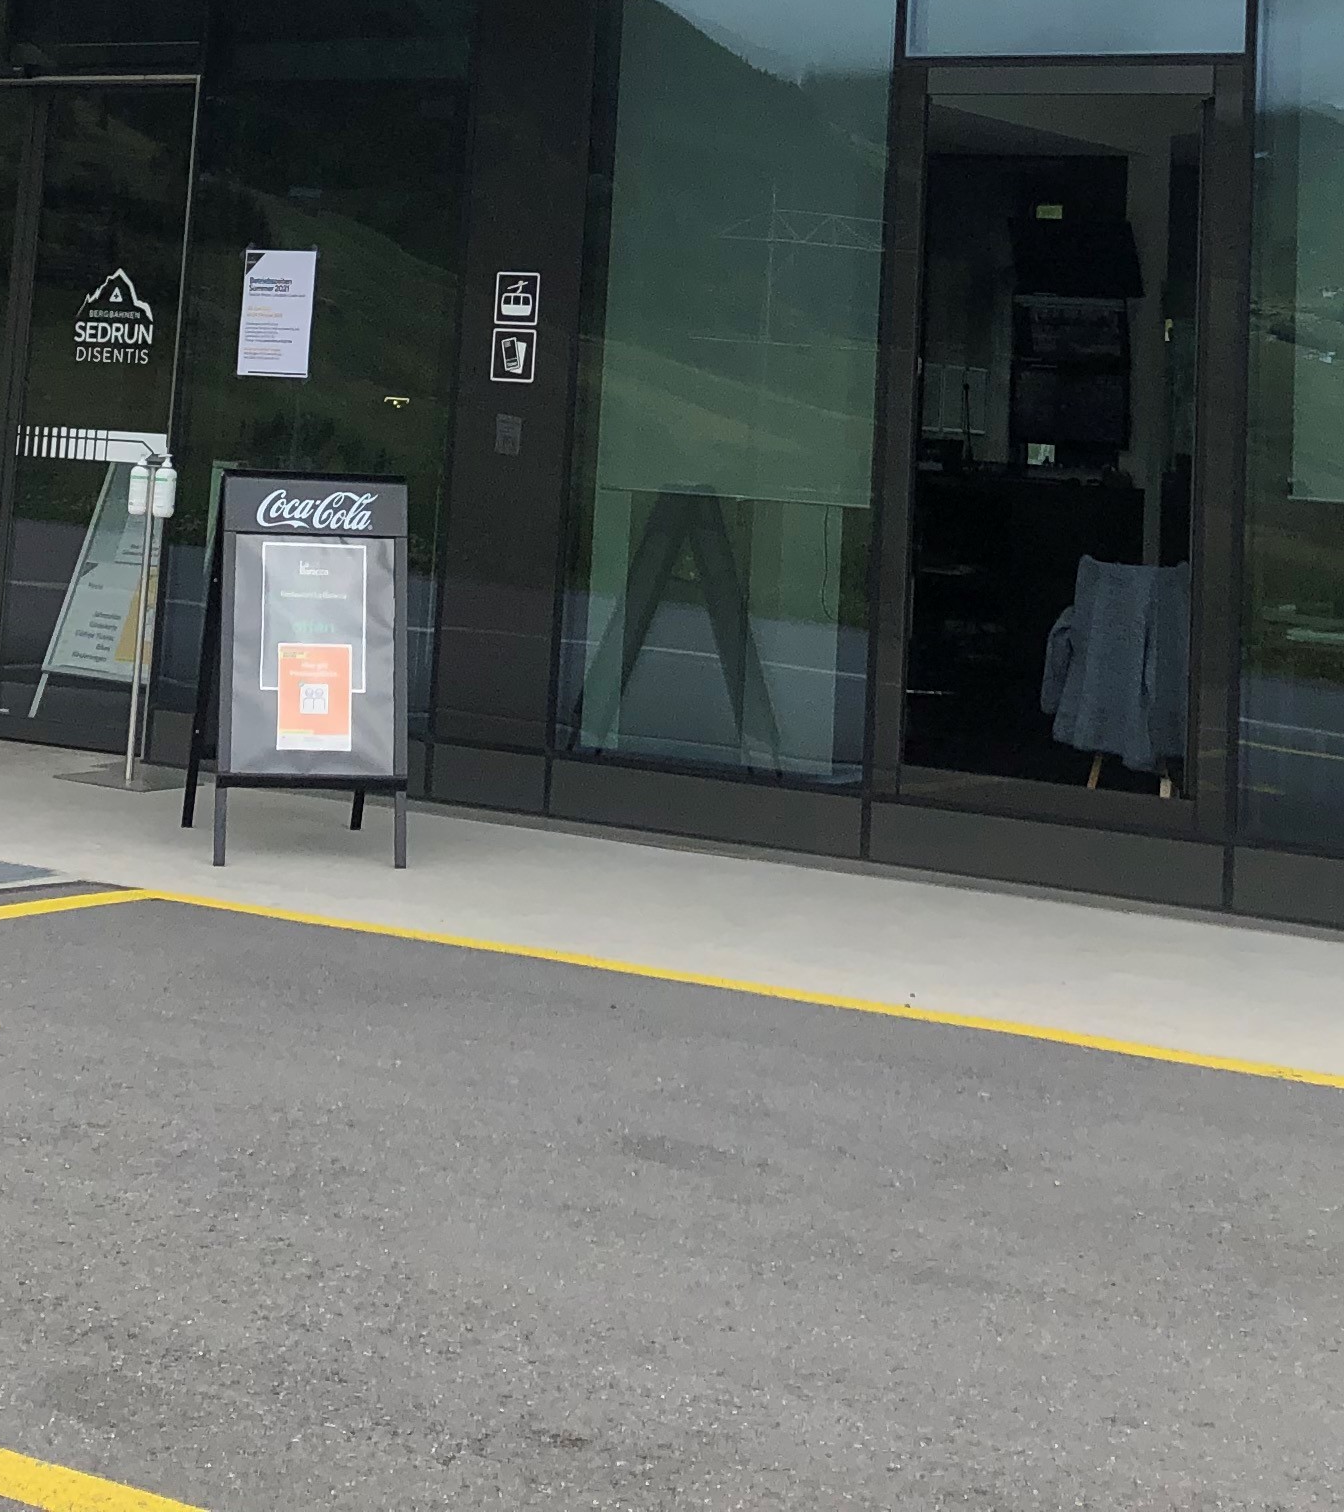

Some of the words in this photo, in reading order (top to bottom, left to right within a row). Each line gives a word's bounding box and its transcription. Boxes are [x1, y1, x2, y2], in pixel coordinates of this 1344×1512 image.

[89, 309, 141, 319] BERGBAHNEN
[74, 321, 153, 345] SEDRUN
[75, 346, 149, 364] DISENTIS
